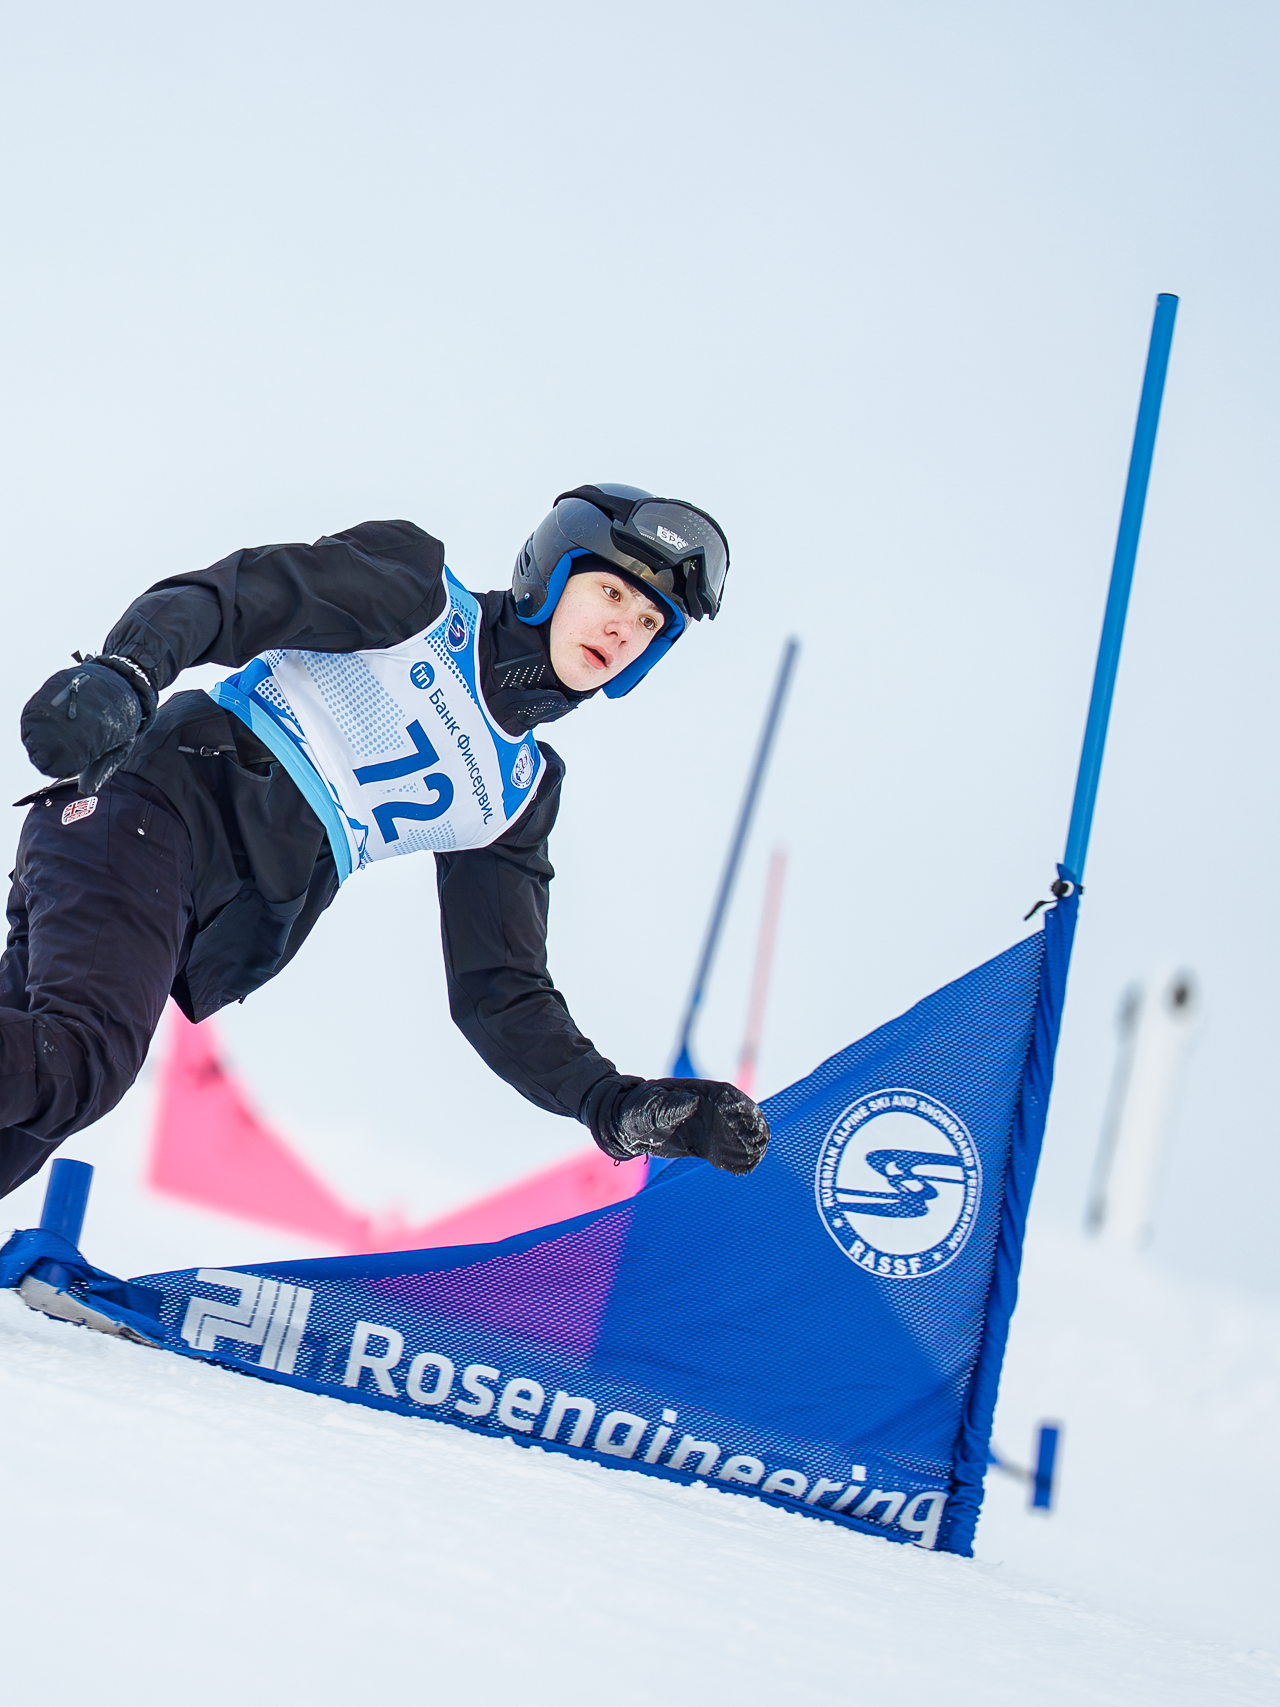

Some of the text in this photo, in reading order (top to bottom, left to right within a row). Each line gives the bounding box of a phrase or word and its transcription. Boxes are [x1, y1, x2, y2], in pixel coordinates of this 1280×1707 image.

[412, 663, 432, 688] fin
[352, 719, 455, 844] 72
[429, 688, 461, 736] Банк
[457, 733, 495, 825] Финсервис
[821, 1095, 978, 1251] RUSSIAN ALPINE SKI AND SNOWBOARD FEDERATION
[849, 1240, 922, 1276] RASSF
